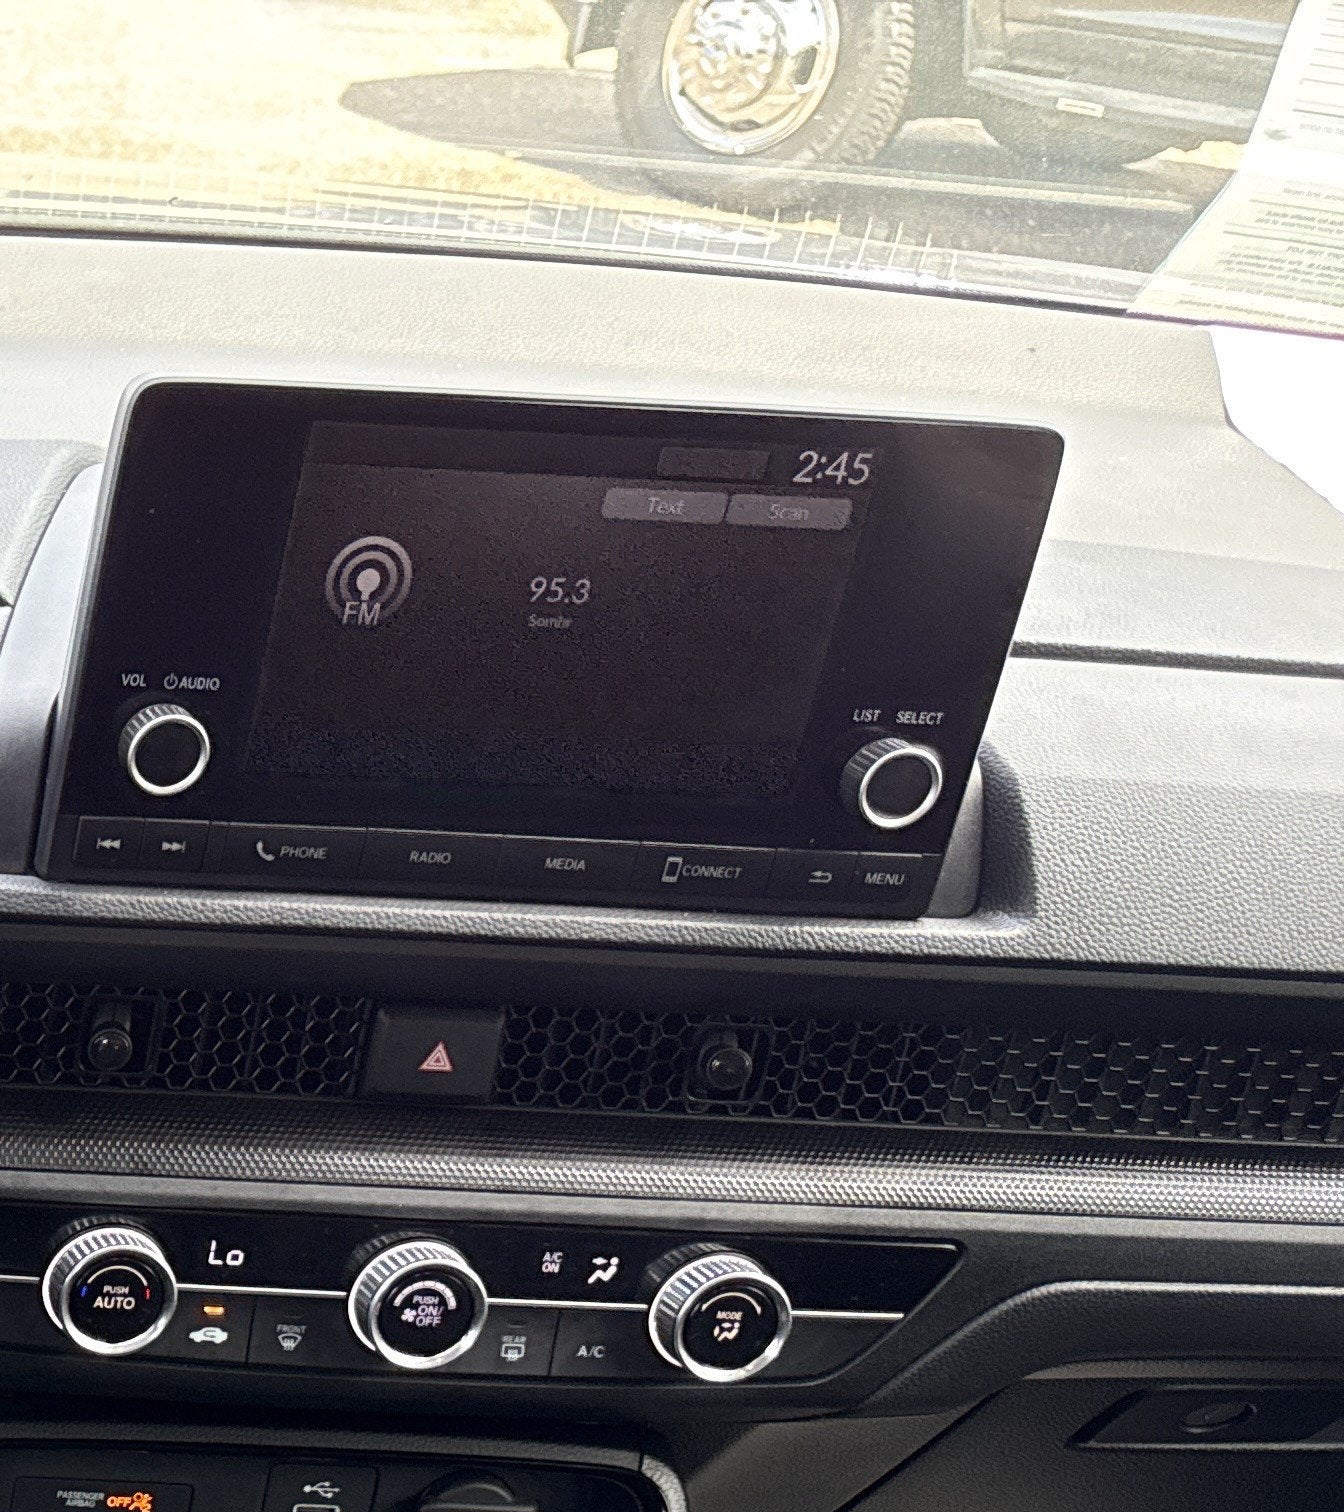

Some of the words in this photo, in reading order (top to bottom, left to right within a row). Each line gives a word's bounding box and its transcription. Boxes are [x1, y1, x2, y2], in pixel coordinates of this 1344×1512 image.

[793, 450, 873, 485] 2:45
[648, 497, 686, 516] Text
[768, 503, 810, 522] Scan
[529, 576, 591, 605] 95.3
[342, 601, 381, 626] FM
[121, 673, 147, 688] VOL
[178, 675, 220, 692] AUDIO
[852, 708, 881, 723] LIST
[896, 709, 944, 726] SELECT
[279, 845, 328, 861] PHONE
[409, 850, 452, 866] RADIO
[544, 856, 586, 872] MEDIA
[682, 864, 742, 880] CONNECT
[864, 871, 905, 886] MENU
[208, 1239, 245, 1267] Lo
[542, 1251, 563, 1263] A/C
[541, 1262, 560, 1273] ON
[102, 1284, 129, 1295] PUSH
[93, 1296, 136, 1310] AUTO
[412, 1294, 439, 1305] PUSH
[417, 1304, 444, 1317] ON/
[716, 1310, 744, 1321] MODE
[275, 1323, 307, 1334] FRONT
[415, 1316, 442, 1328] OFF
[575, 1345, 605, 1358] A/C
[106, 1495, 132, 1508] OFF
